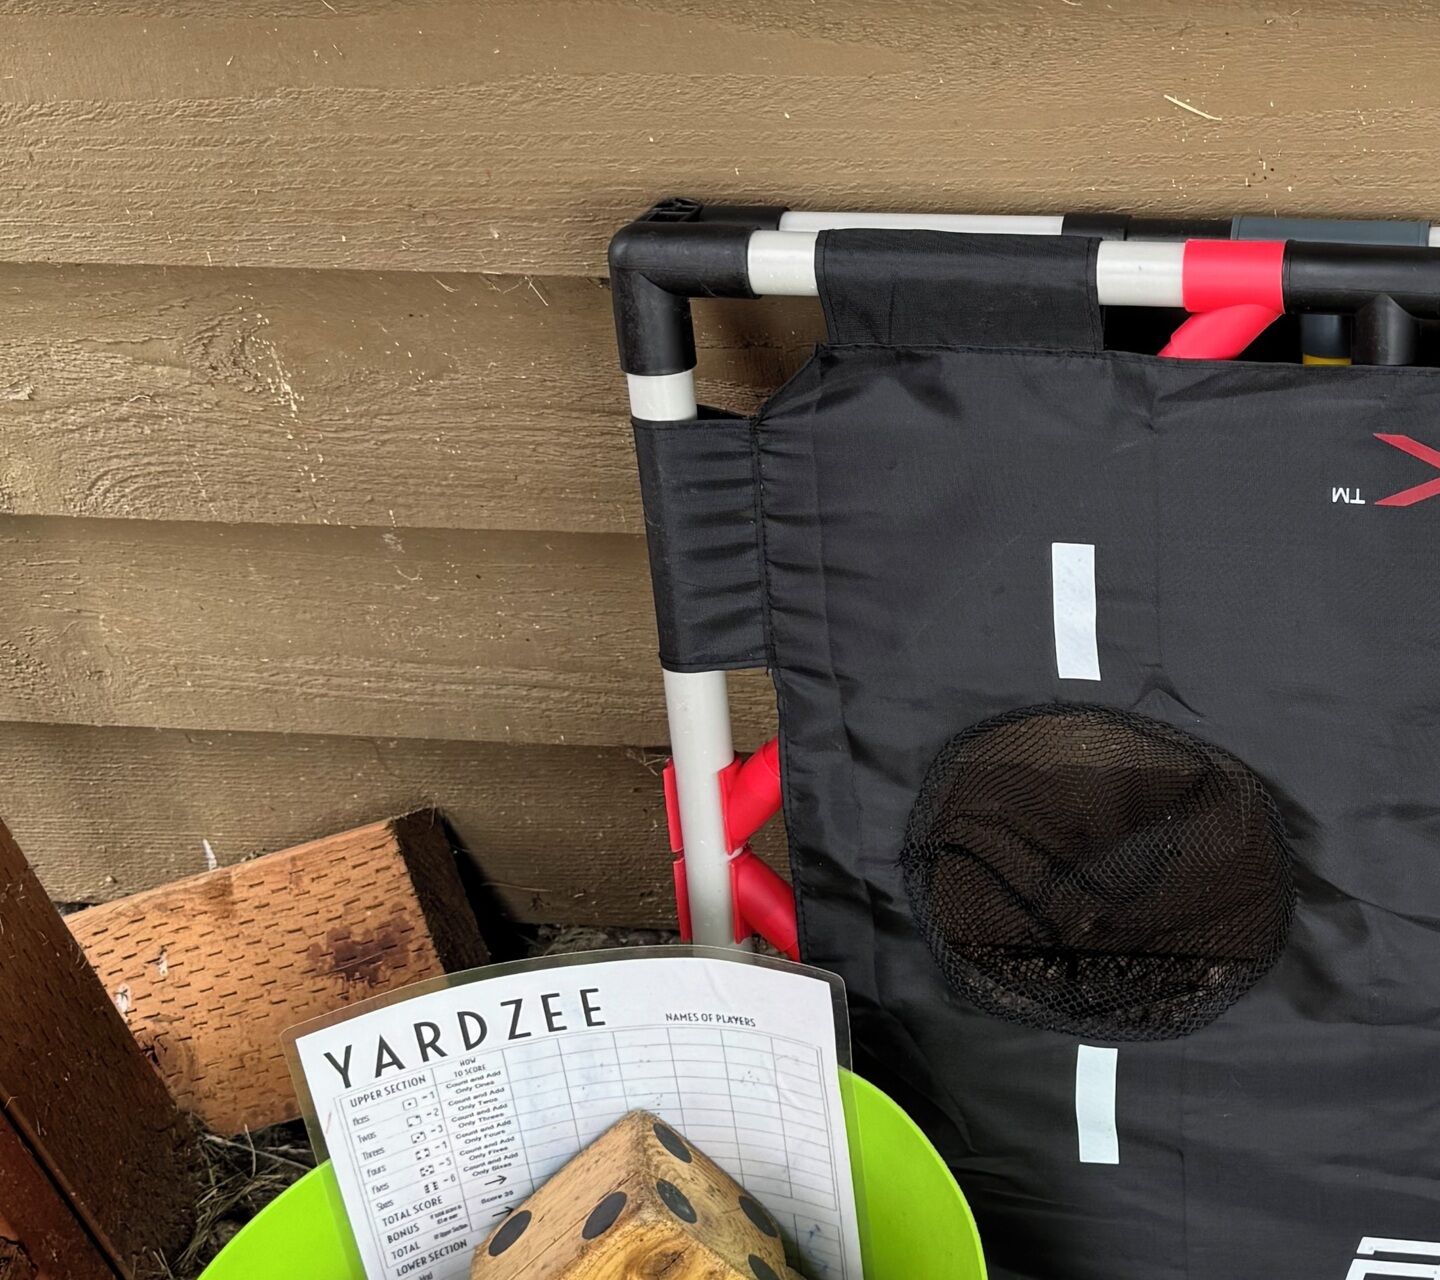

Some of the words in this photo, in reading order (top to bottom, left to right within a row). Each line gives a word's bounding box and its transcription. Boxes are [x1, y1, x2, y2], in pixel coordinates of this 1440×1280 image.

[665, 1012, 699, 1022] NAMES
[700, 1013, 713, 1022] OF
[715, 1014, 756, 1027] PLAYERS
[323, 987, 606, 1089] YARDZEE
[459, 1057, 476, 1067] HOW
[454, 1070, 464, 1078] TO
[464, 1064, 486, 1076] SCORE
[486, 1070, 501, 1079] Add
[350, 1089, 383, 1108] UPPER
[383, 1074, 427, 1096] SECTION
[455, 1086, 473, 1095] Only
[474, 1080, 495, 1089] Ones
[489, 1087, 505, 1096] Add
[457, 1103, 476, 1112] Only
[492, 1103, 508, 1111] Add
[458, 1120, 476, 1129] Only
[478, 1113, 504, 1122] Threes
[496, 1120, 512, 1129] Add
[464, 1136, 482, 1145] Only
[499, 1136, 515, 1145] Add
[468, 1153, 487, 1161] Only
[503, 1152, 519, 1161] Add
[472, 1169, 490, 1177] Only
[382, 1209, 412, 1227] TOTAL
[412, 1195, 443, 1215] SCORE
[386, 1222, 420, 1244] BONUS
[391, 1241, 421, 1260] TOTAL
[396, 1255, 428, 1277] LOWER
[428, 1238, 467, 1263] SECTION
